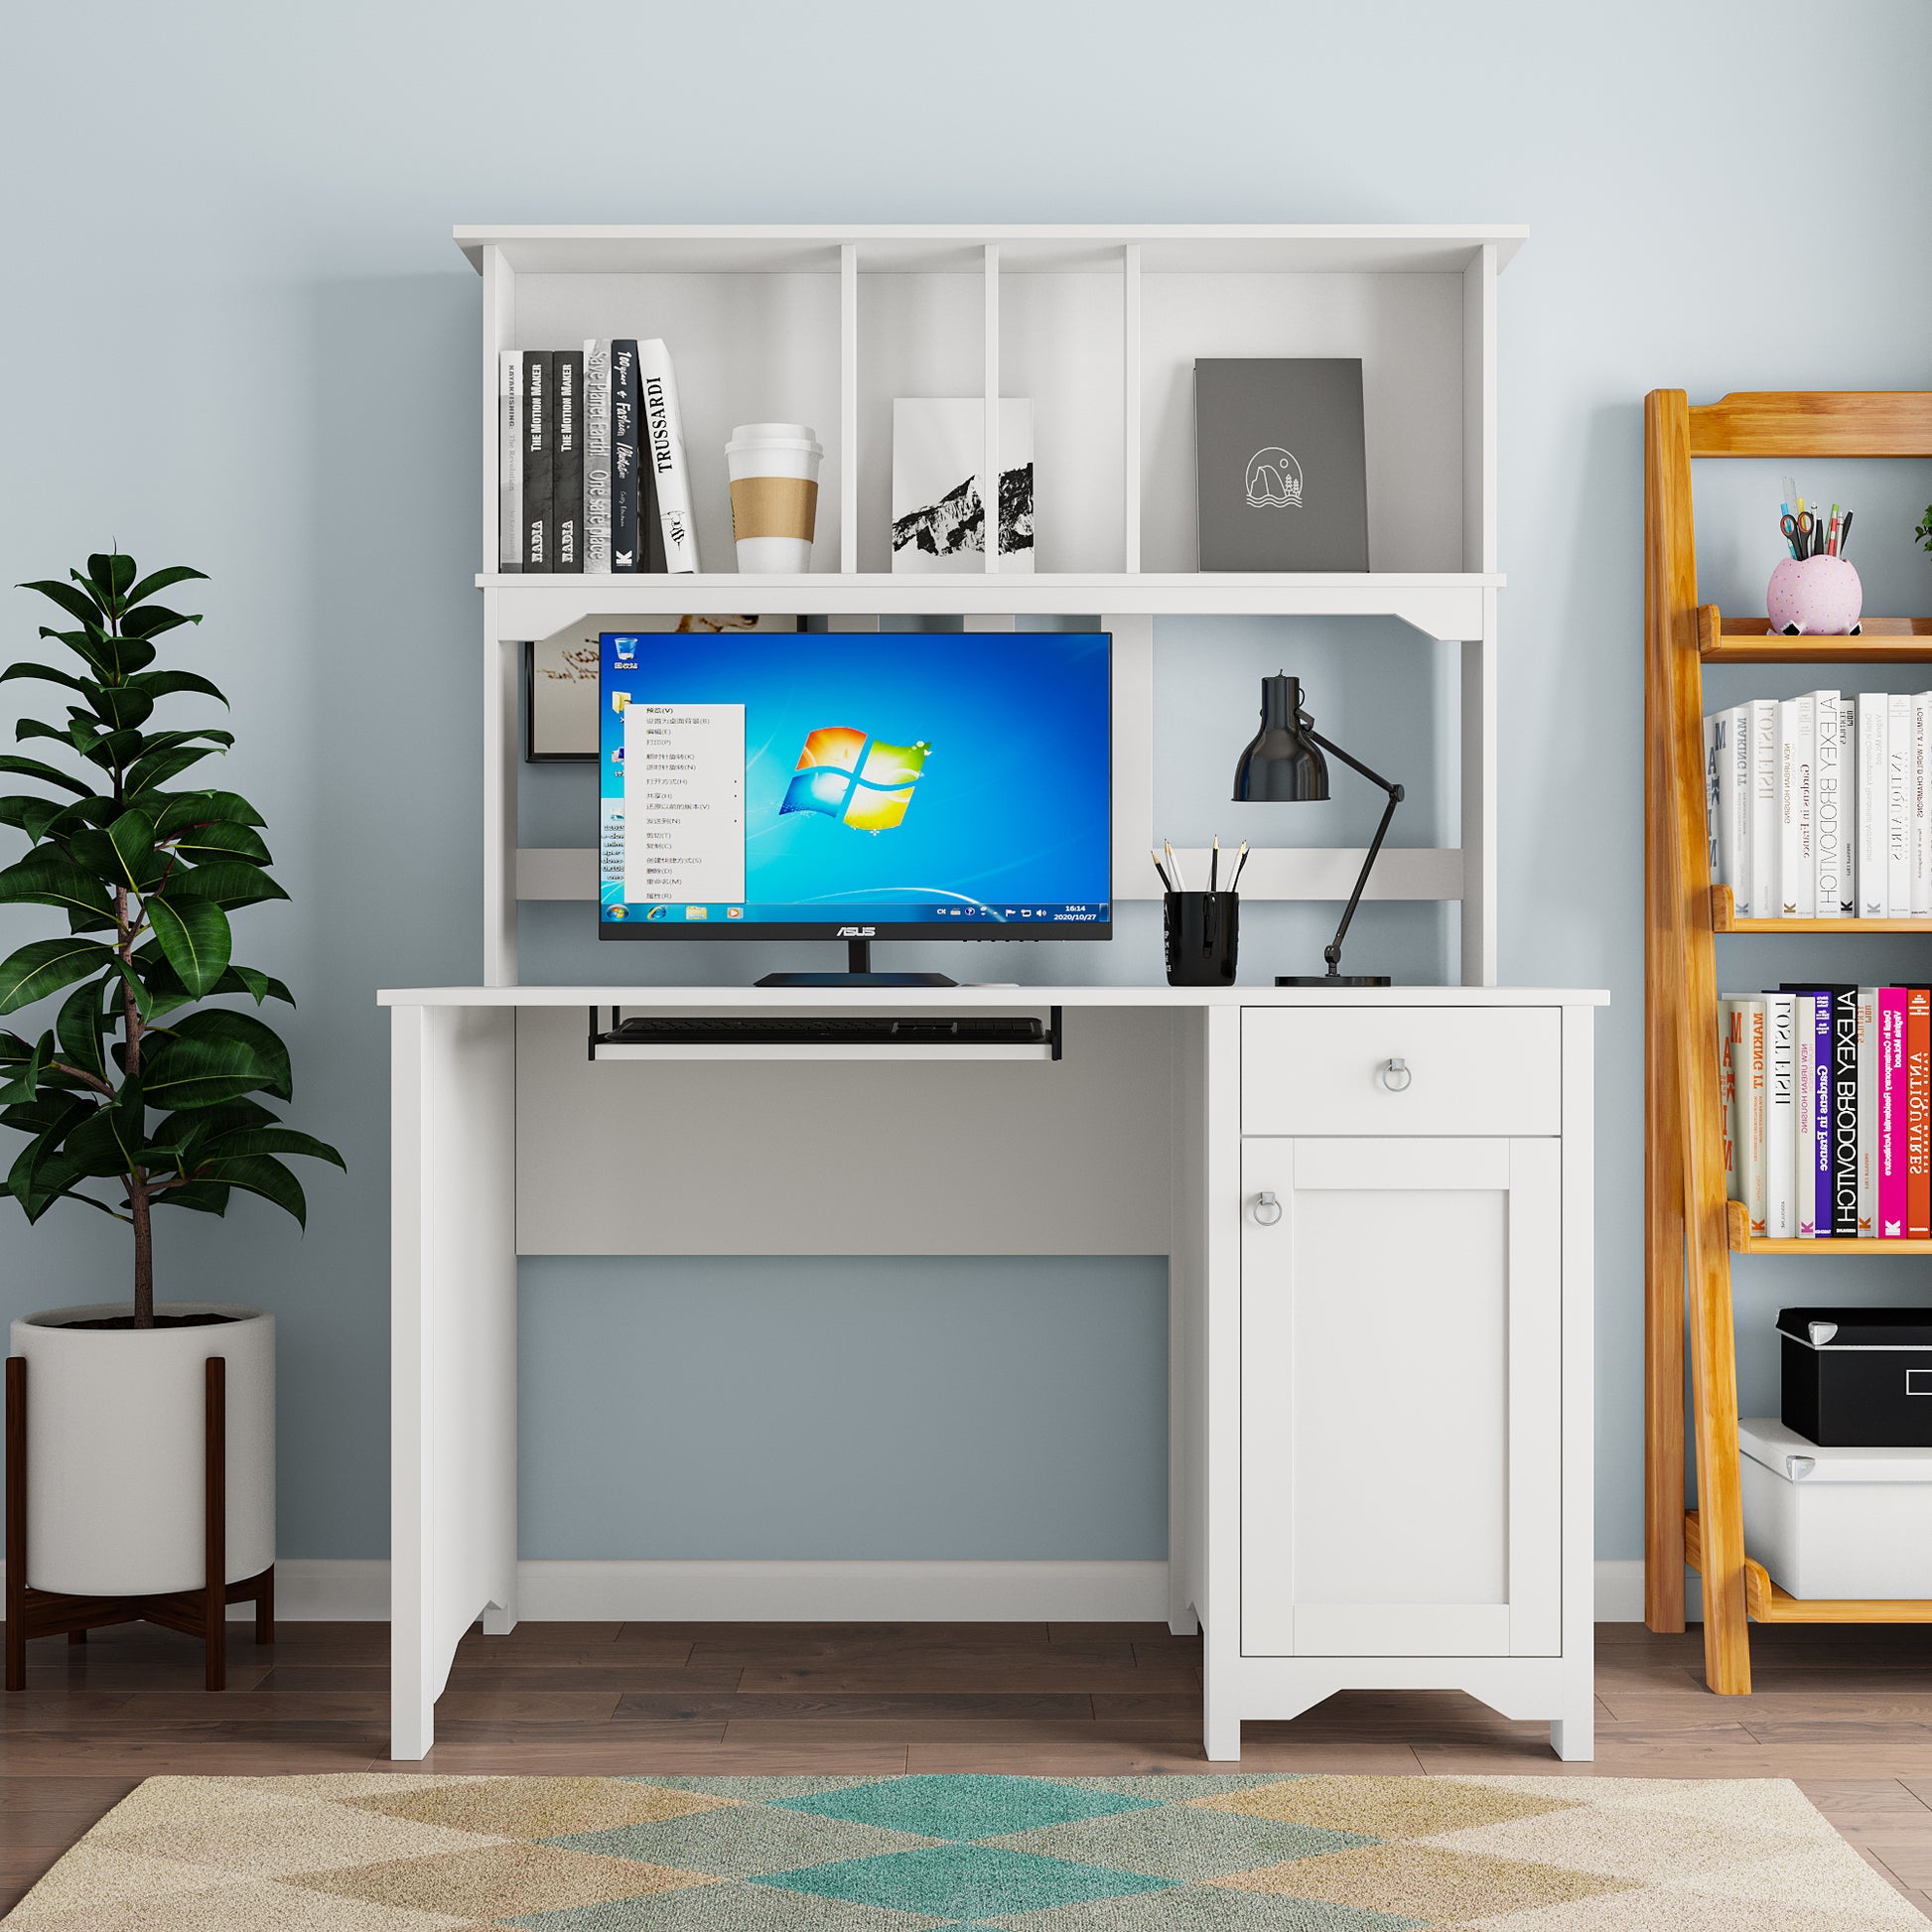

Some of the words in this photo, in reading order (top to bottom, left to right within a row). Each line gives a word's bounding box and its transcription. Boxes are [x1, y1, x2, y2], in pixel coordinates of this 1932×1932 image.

[530, 364, 541, 396] MAKER
[561, 364, 572, 396] MAKER
[589, 350, 609, 379] Save
[530, 398, 541, 434] MOTION
[561, 398, 572, 434] MOTION
[589, 383, 609, 419] Planet
[616, 402, 630, 436] Fashion
[646, 375, 673, 474] TRUSSARDI
[589, 422, 609, 457] Earth!
[587, 470, 609, 495] One
[587, 498, 609, 524] safe
[531, 520, 543, 563] NADIA
[562, 520, 574, 563] NADIA
[587, 526, 609, 559] place
[837, 926, 876, 936] ASUS
